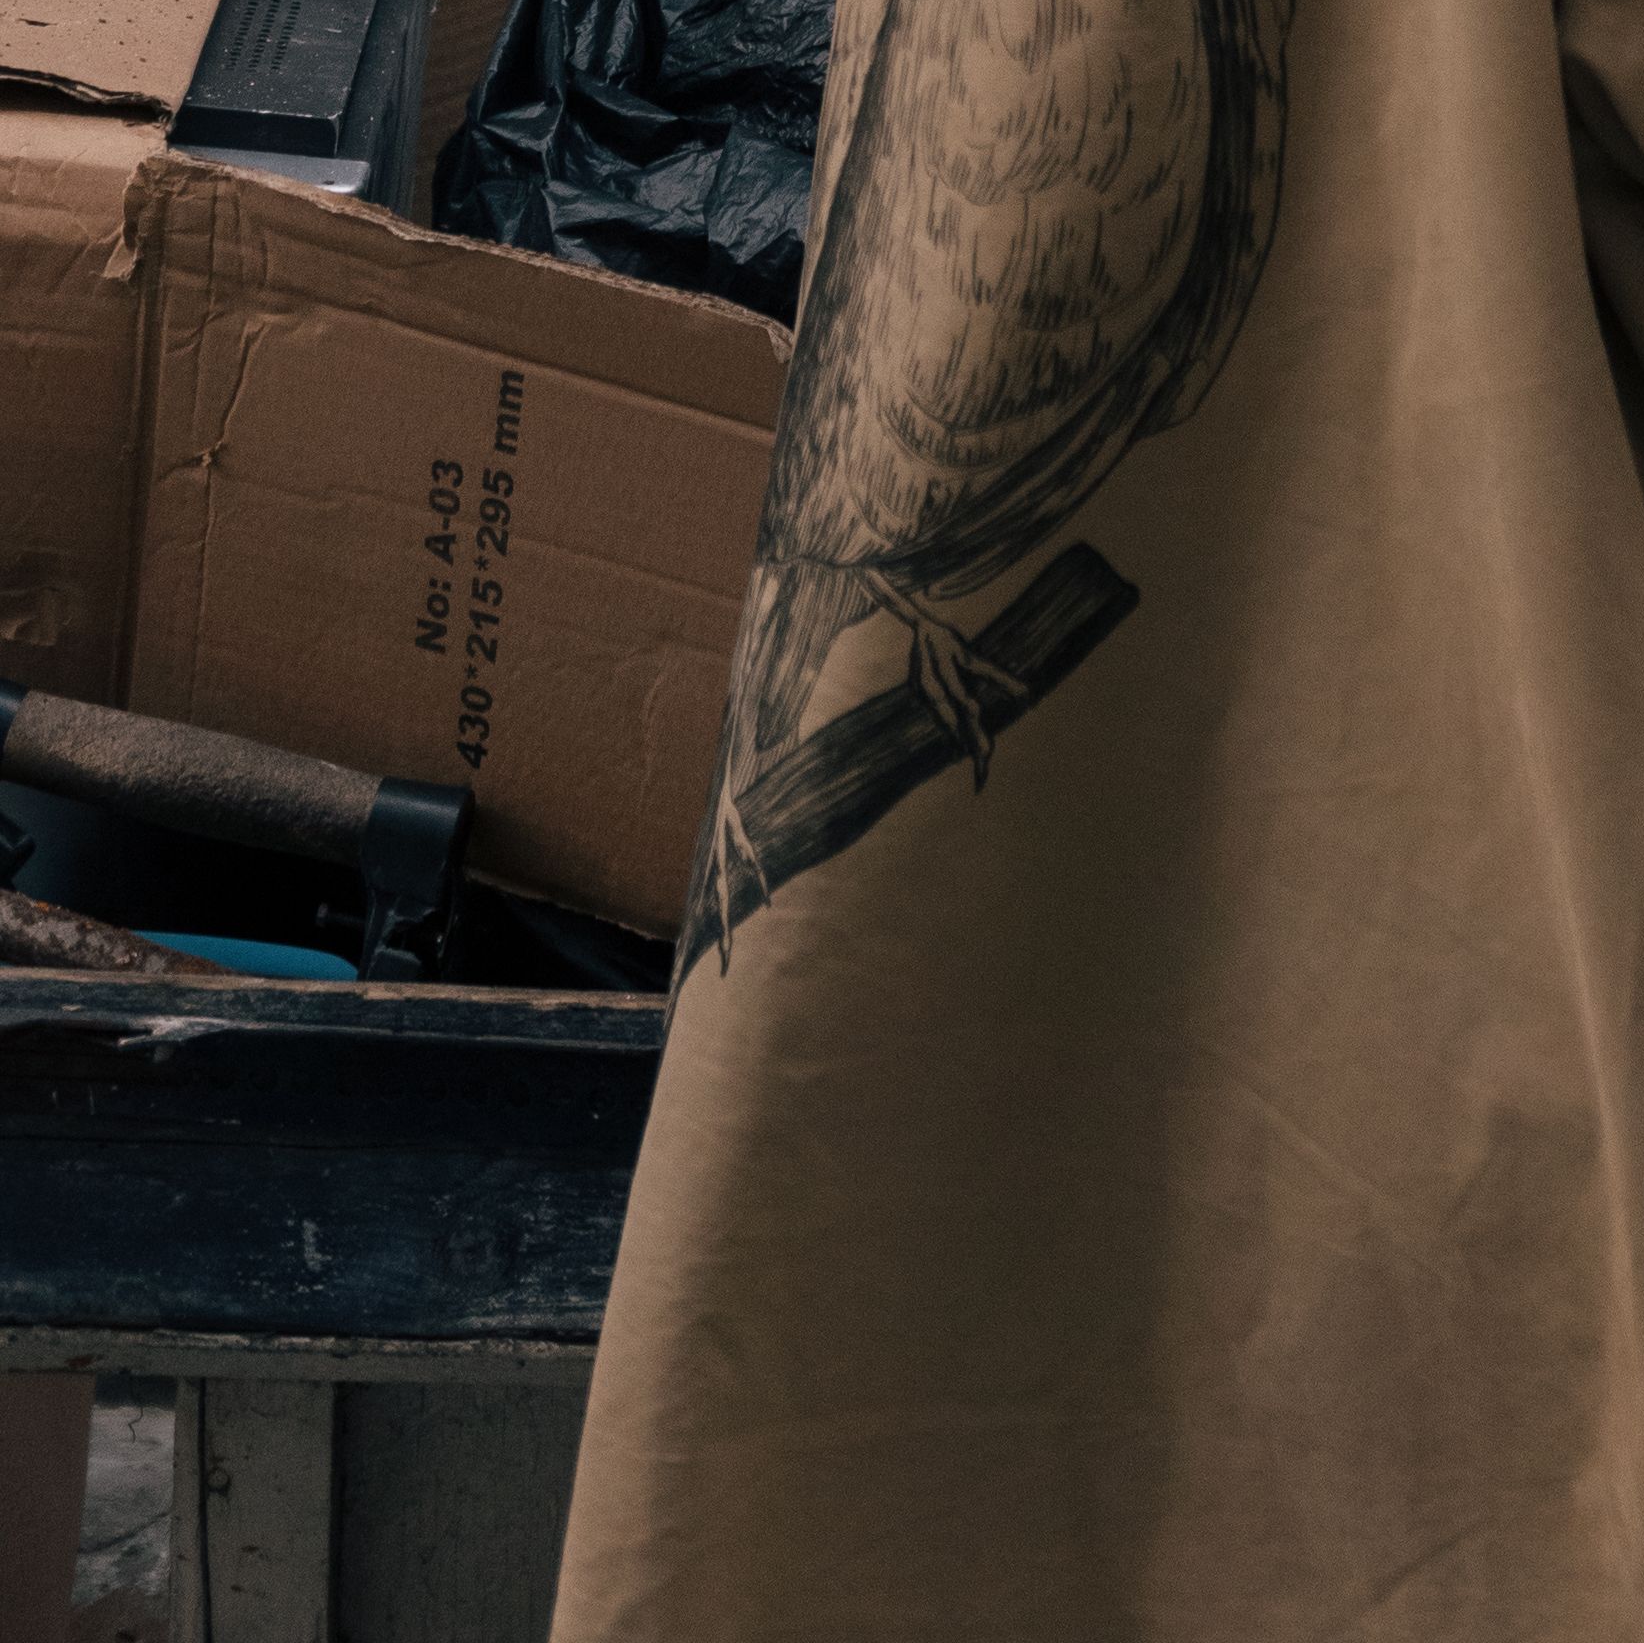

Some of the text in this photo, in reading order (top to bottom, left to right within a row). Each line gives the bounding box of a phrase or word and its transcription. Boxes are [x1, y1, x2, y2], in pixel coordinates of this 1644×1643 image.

[493, 369, 525, 457] mm
[414, 458, 464, 655] No: A-03
